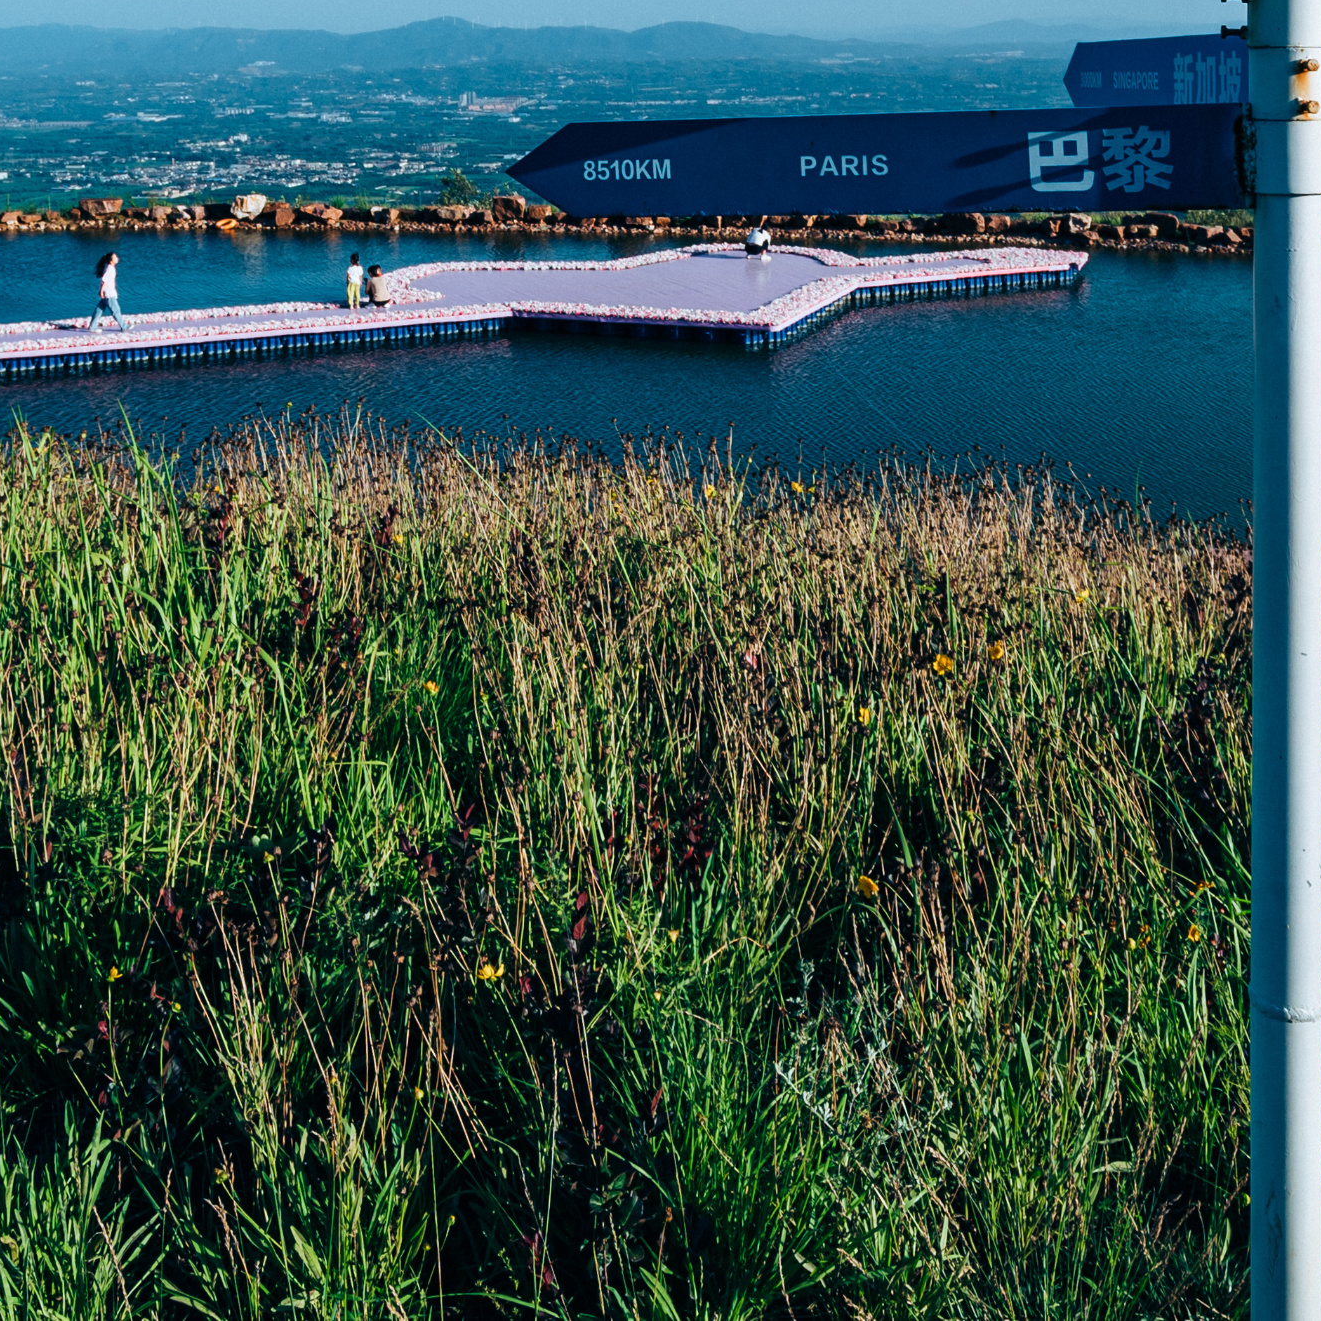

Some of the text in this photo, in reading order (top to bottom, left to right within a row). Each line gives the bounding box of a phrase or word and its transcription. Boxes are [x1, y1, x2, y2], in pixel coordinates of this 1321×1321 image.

[1113, 71, 1159, 90] SINGAPORE
[1172, 50, 1242, 105] 新加坡
[583, 126, 1175, 196] 8510KM PARIS 巴黎
